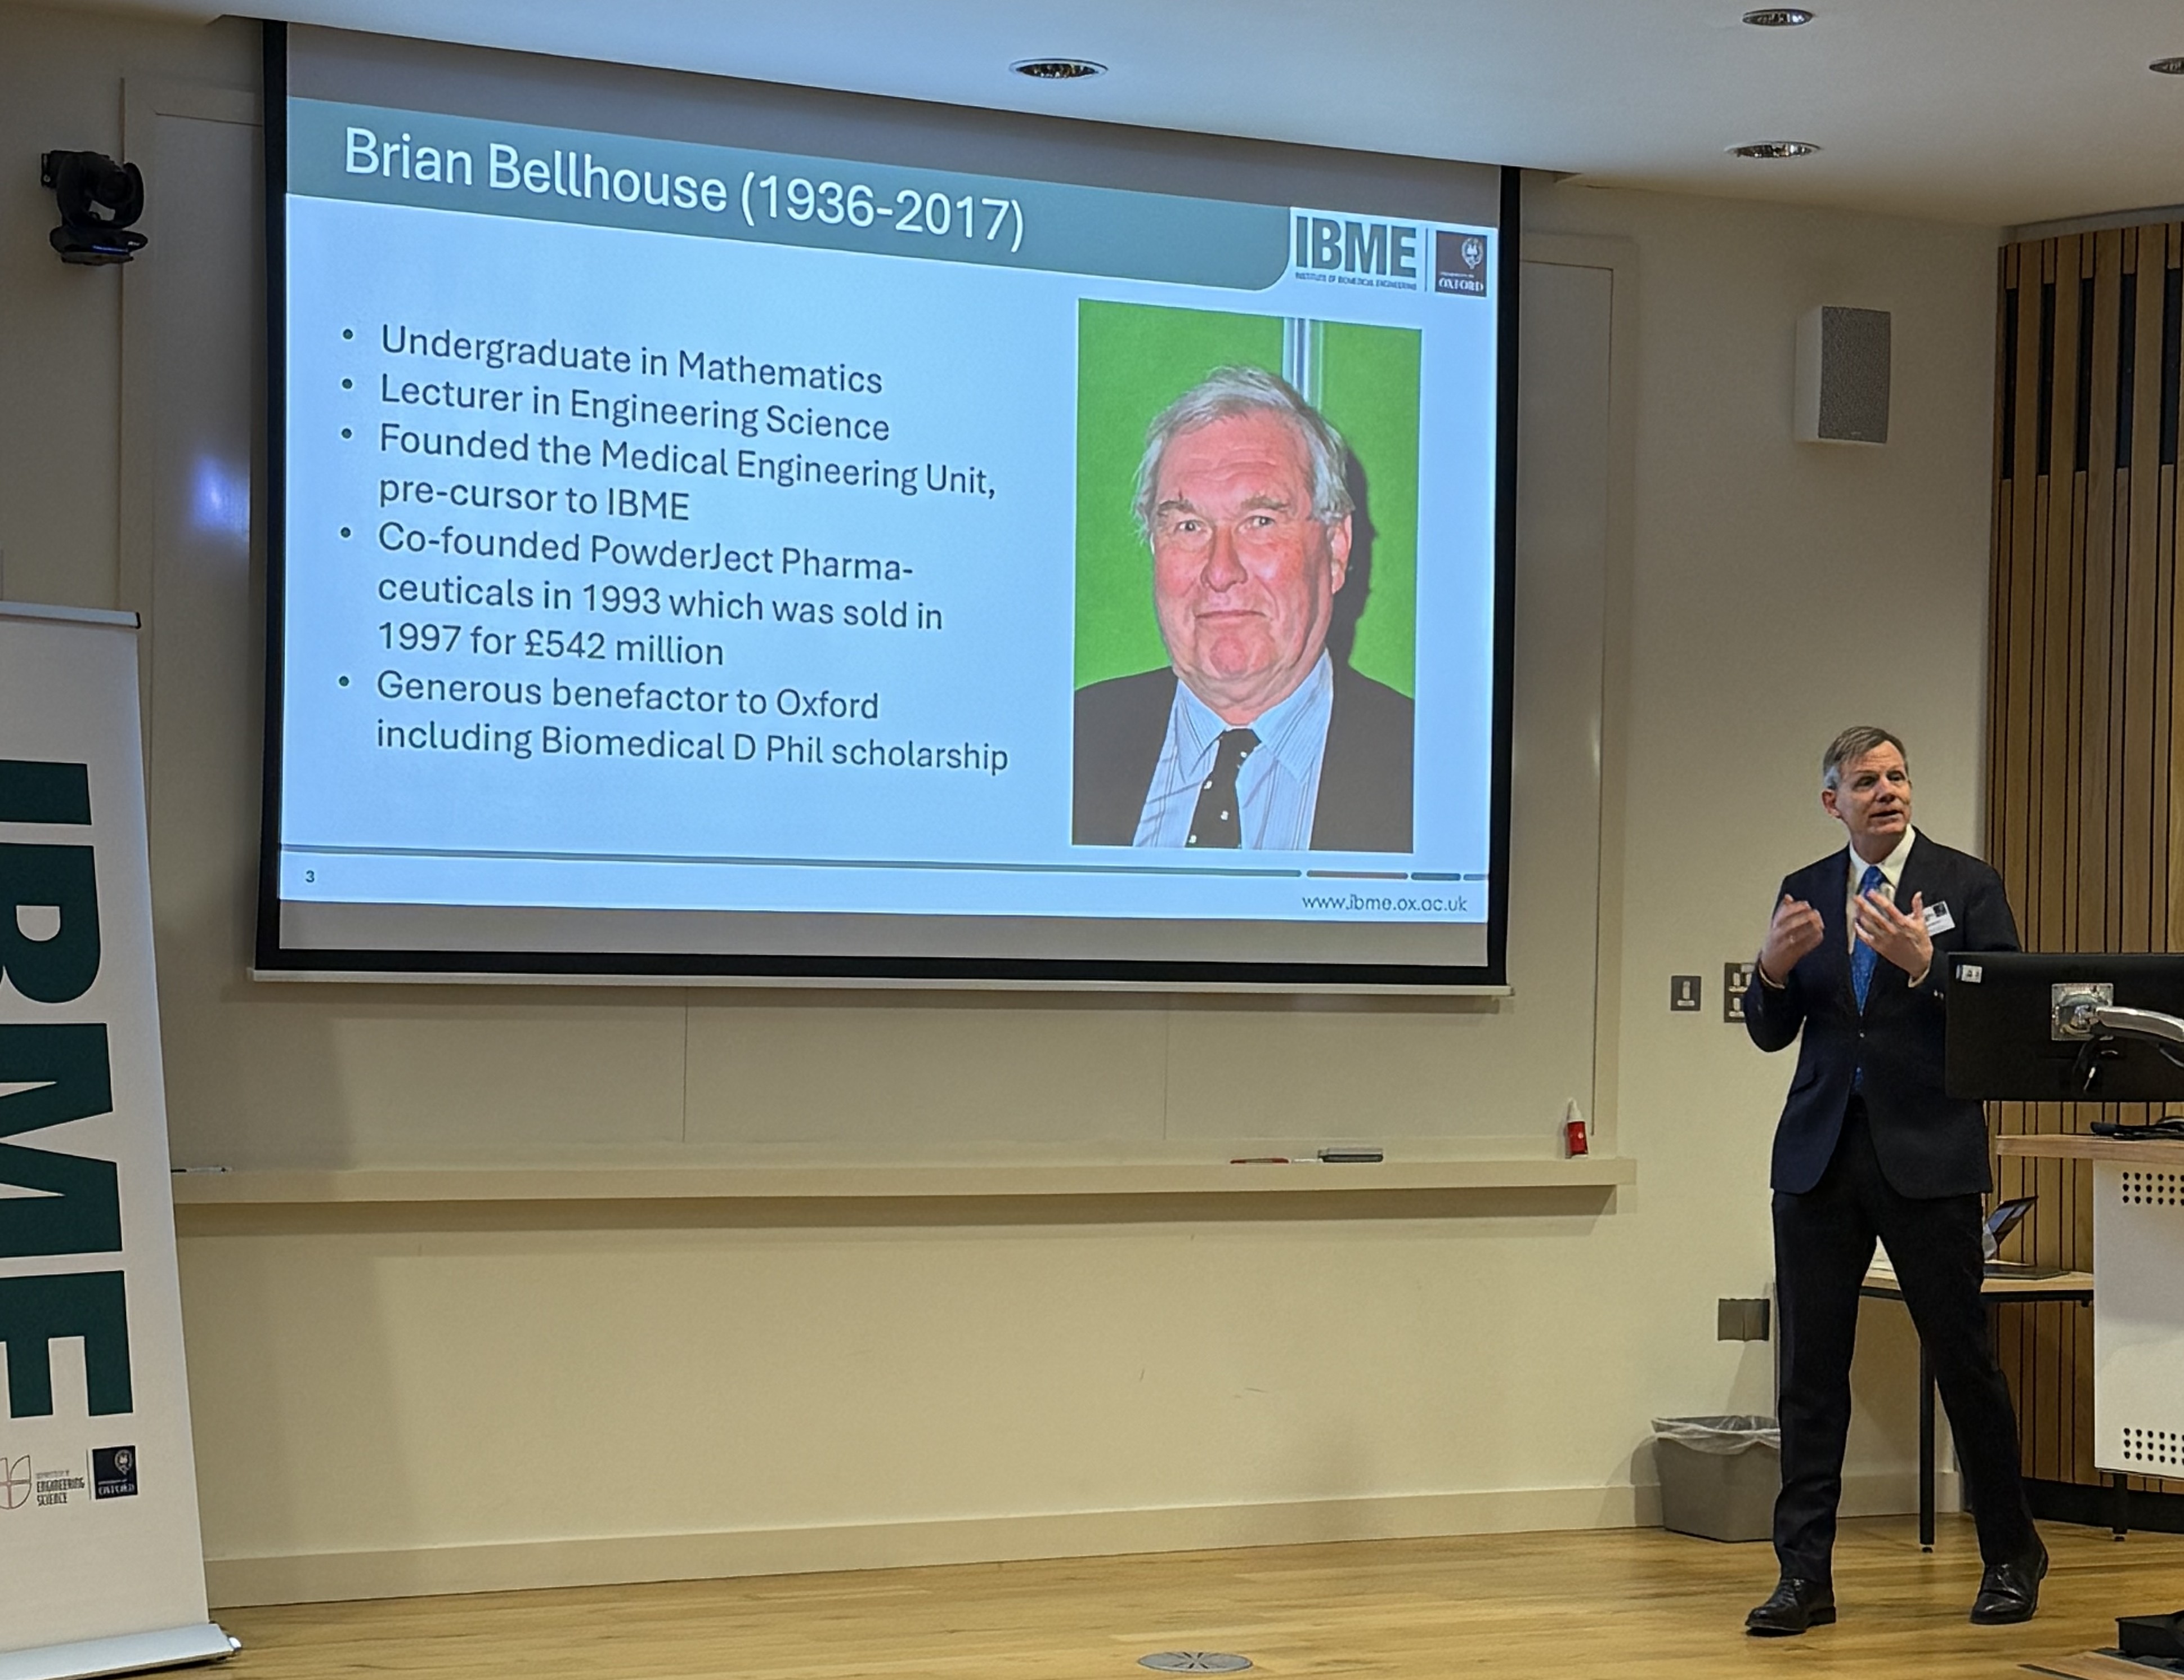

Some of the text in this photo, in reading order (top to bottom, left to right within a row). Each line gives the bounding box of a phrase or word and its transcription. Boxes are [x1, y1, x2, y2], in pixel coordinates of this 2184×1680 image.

[346, 126, 1024, 253] Brian Bellhouse (1936-2017)
[1296, 216, 1416, 278] IBME
[1438, 277, 1484, 292] OXFORD
[382, 323, 883, 395] Undergraduate in Mathematics
[382, 372, 890, 442] Lecturer in Engineering Science
[380, 422, 995, 500] Founded the Medical Engineering Unit,
[380, 479, 690, 522] pre-cursor to IBME
[378, 521, 914, 581] Co-founded PowderJect Pharma-
[378, 574, 943, 631] ceuticals in 1993 which was sold in
[378, 621, 724, 666] 1997 for £542 million
[376, 669, 879, 720] Generous benefactor to Oxford
[377, 718, 1008, 777] including Biomedical D Phil scholarship
[306, 870, 315, 882] 3
[1302, 894, 1468, 912] www.ibme.ox.ac.uk
